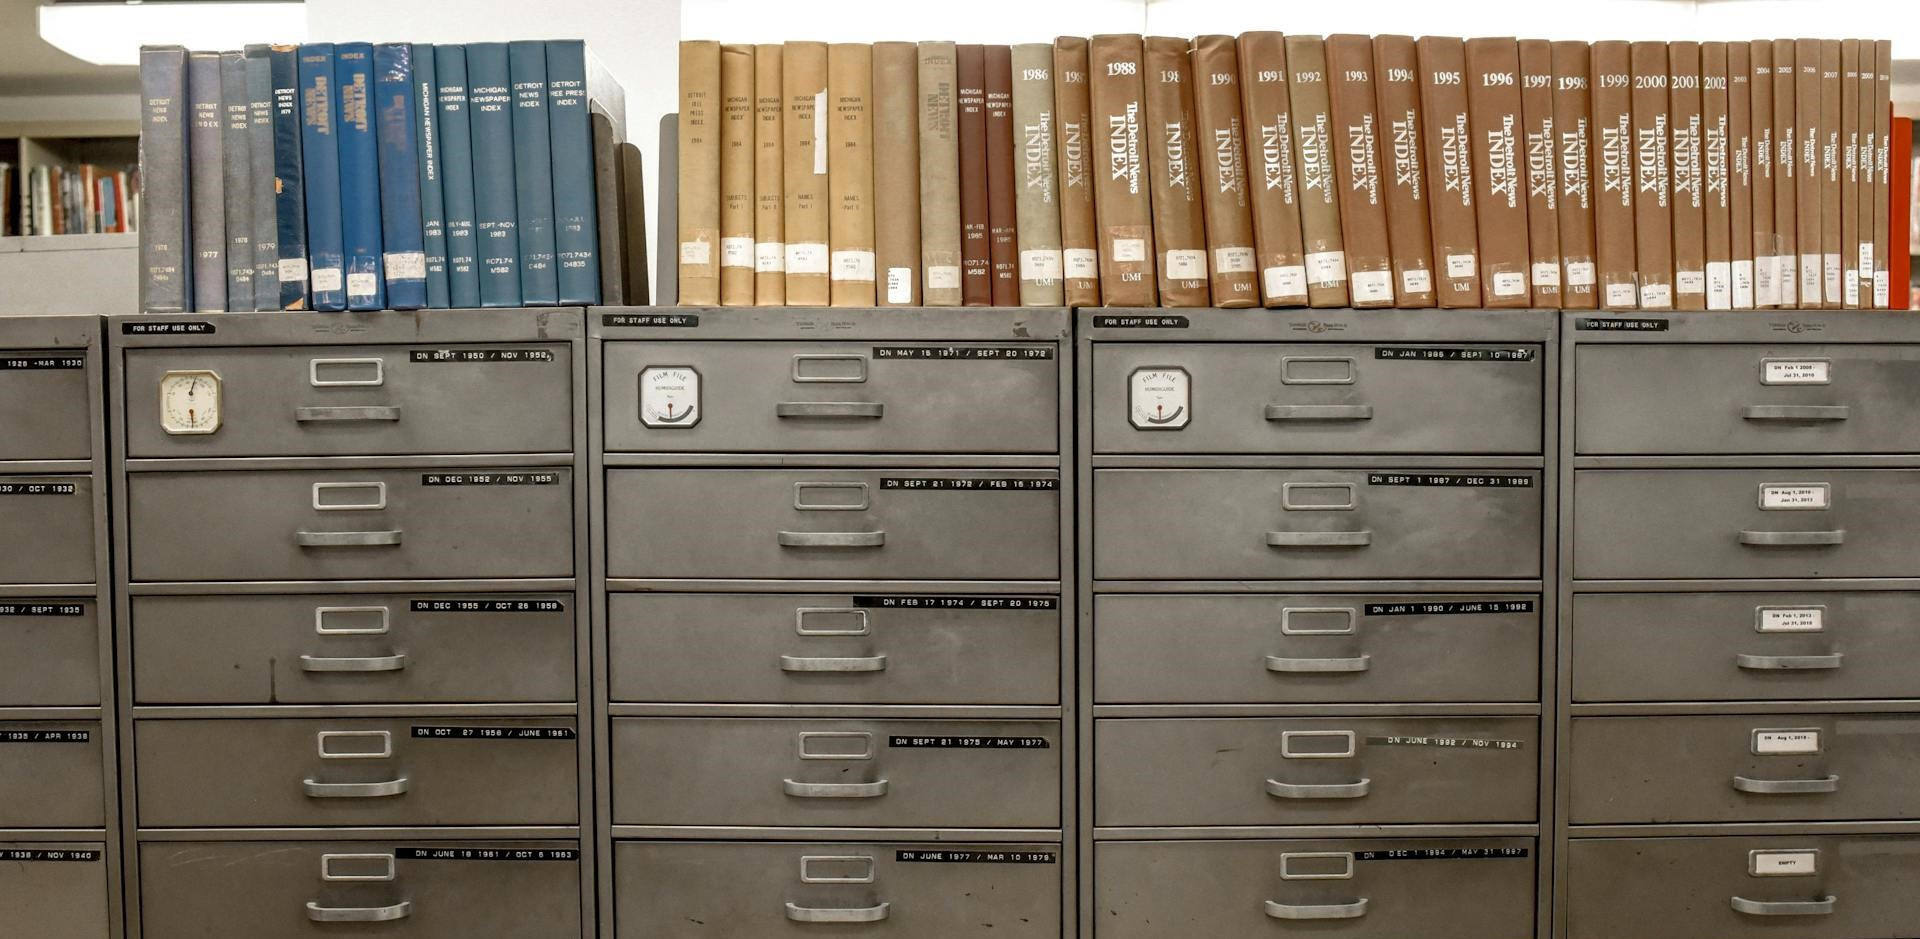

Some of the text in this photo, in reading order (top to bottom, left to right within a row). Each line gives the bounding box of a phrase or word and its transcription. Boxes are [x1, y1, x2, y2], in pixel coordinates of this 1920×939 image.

[1022, 69, 1049, 81] 1986
[1106, 62, 1136, 76] 1988
[1257, 70, 1285, 82] 1991
[1296, 71, 1322, 83] 1992
[1345, 70, 1369, 82] 1993
[1387, 68, 1415, 82] 1994
[1433, 71, 1461, 85] 1995
[1482, 72, 1514, 87] 1996
[1599, 74, 1629, 88] 1999
[1756, 67, 1770, 75] 2004
[1823, 71, 1838, 79] 2007
[473, 86, 507, 94] MICHIGAN
[514, 82, 543, 90] DETROIT
[551, 80, 581, 88] DETROIT
[1523, 75, 1552, 88] 1997
[1558, 76, 1588, 91] 1998
[1635, 75, 1667, 89] 2000
[1671, 75, 1700, 89] 2001
[1704, 76, 1727, 90] 2002
[422, 82, 430, 116] MICHIGAN
[519, 91, 539, 99] NEWS
[556, 98, 577, 106] INDEX
[480, 104, 502, 112] INDEX
[424, 117, 433, 158] NEWSPAPER
[1109, 115, 1128, 180] INDEX
[1126, 101, 1140, 194] The Detroit News
[1024, 124, 1042, 188] INDEX
[1065, 122, 1082, 187] INDEX
[1216, 128, 1237, 193] INDEX
[1261, 125, 1282, 191] INDEX
[1277, 112, 1294, 205] The Detroit News
[1300, 125, 1322, 191] INDEX
[1348, 125, 1368, 191] INDEX
[1392, 120, 1412, 186] INDEX
[1441, 126, 1460, 192] INDEX
[1456, 112, 1472, 207] The Detroit News
[1488, 129, 1507, 196] INDEX
[1503, 114, 1518, 208] The Detroit News
[1528, 132, 1547, 198] INDEX
[1562, 131, 1581, 197] INDEX
[1602, 127, 1621, 193] INDEX
[1639, 128, 1657, 193] INDEX
[1655, 113, 1669, 208] The Detroit News
[1673, 128, 1691, 193] INDEX
[1689, 113, 1702, 208] The Detroit News
[1707, 128, 1720, 193] INDEX
[1121, 272, 1142, 282] UMI
[1233, 282, 1252, 292] UMI
